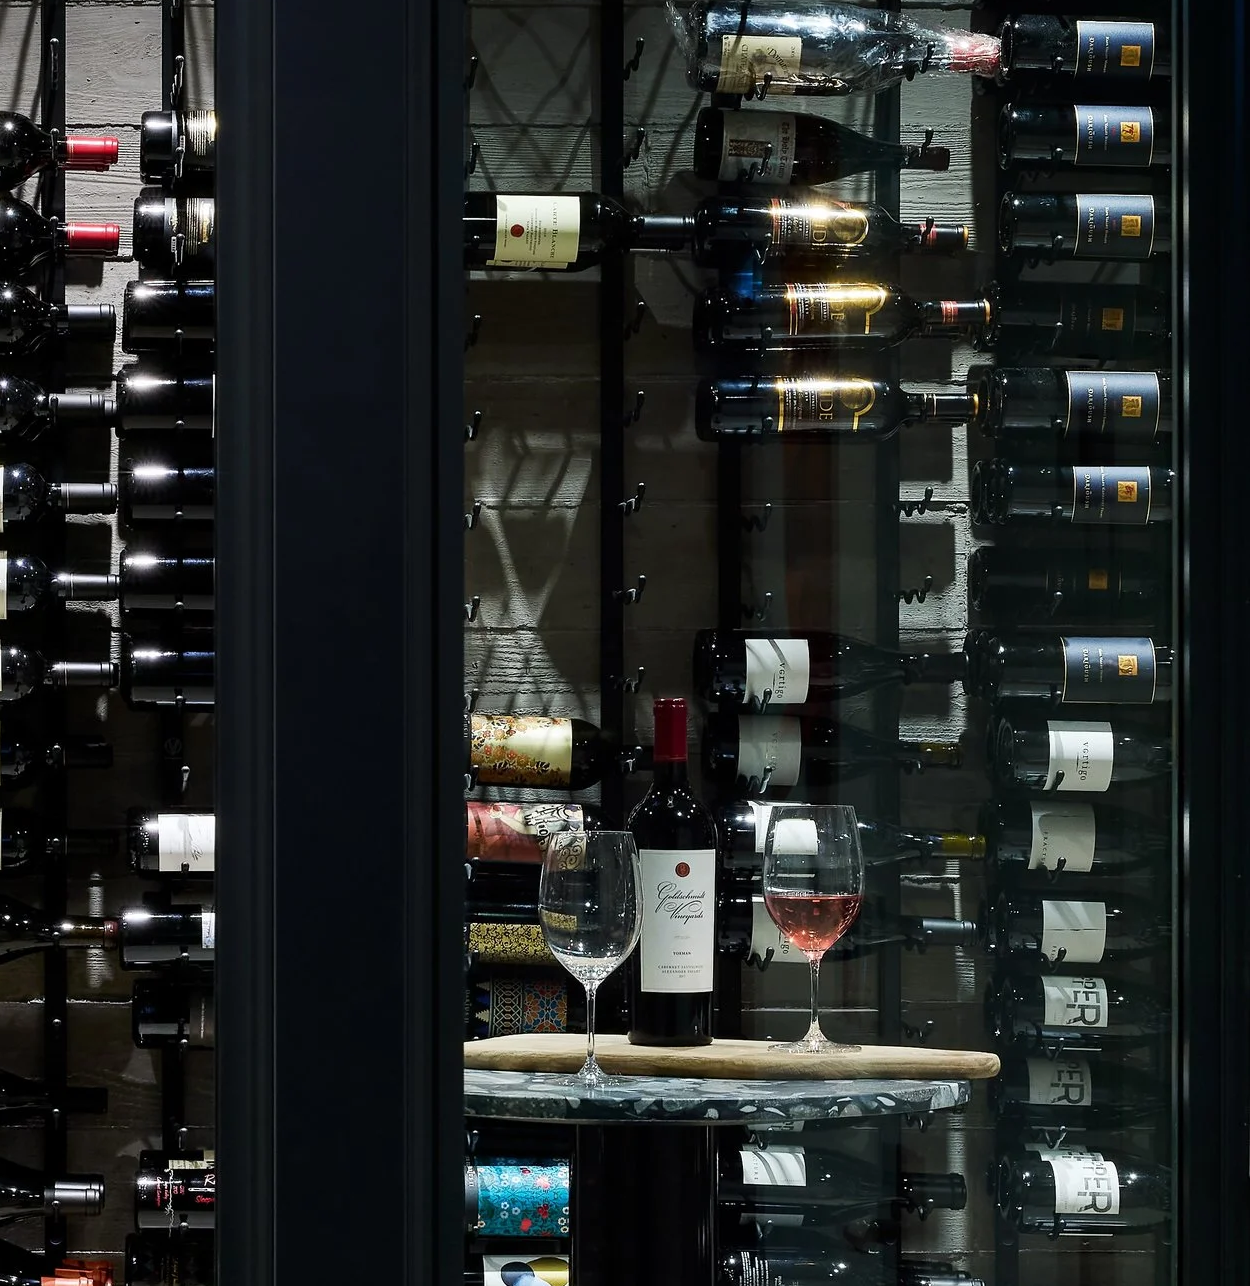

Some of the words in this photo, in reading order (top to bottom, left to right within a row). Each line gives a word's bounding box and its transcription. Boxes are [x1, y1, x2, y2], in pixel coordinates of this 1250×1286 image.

[781, 121, 790, 135] The
[780, 136, 790, 154] Holy
[549, 228, 559, 259] BLANCHE
[774, 662, 787, 699] vertigo
[1077, 741, 1091, 781] vertigo
[654, 880, 706, 912] Goldschmidt
[661, 900, 705, 925] Vineyards
